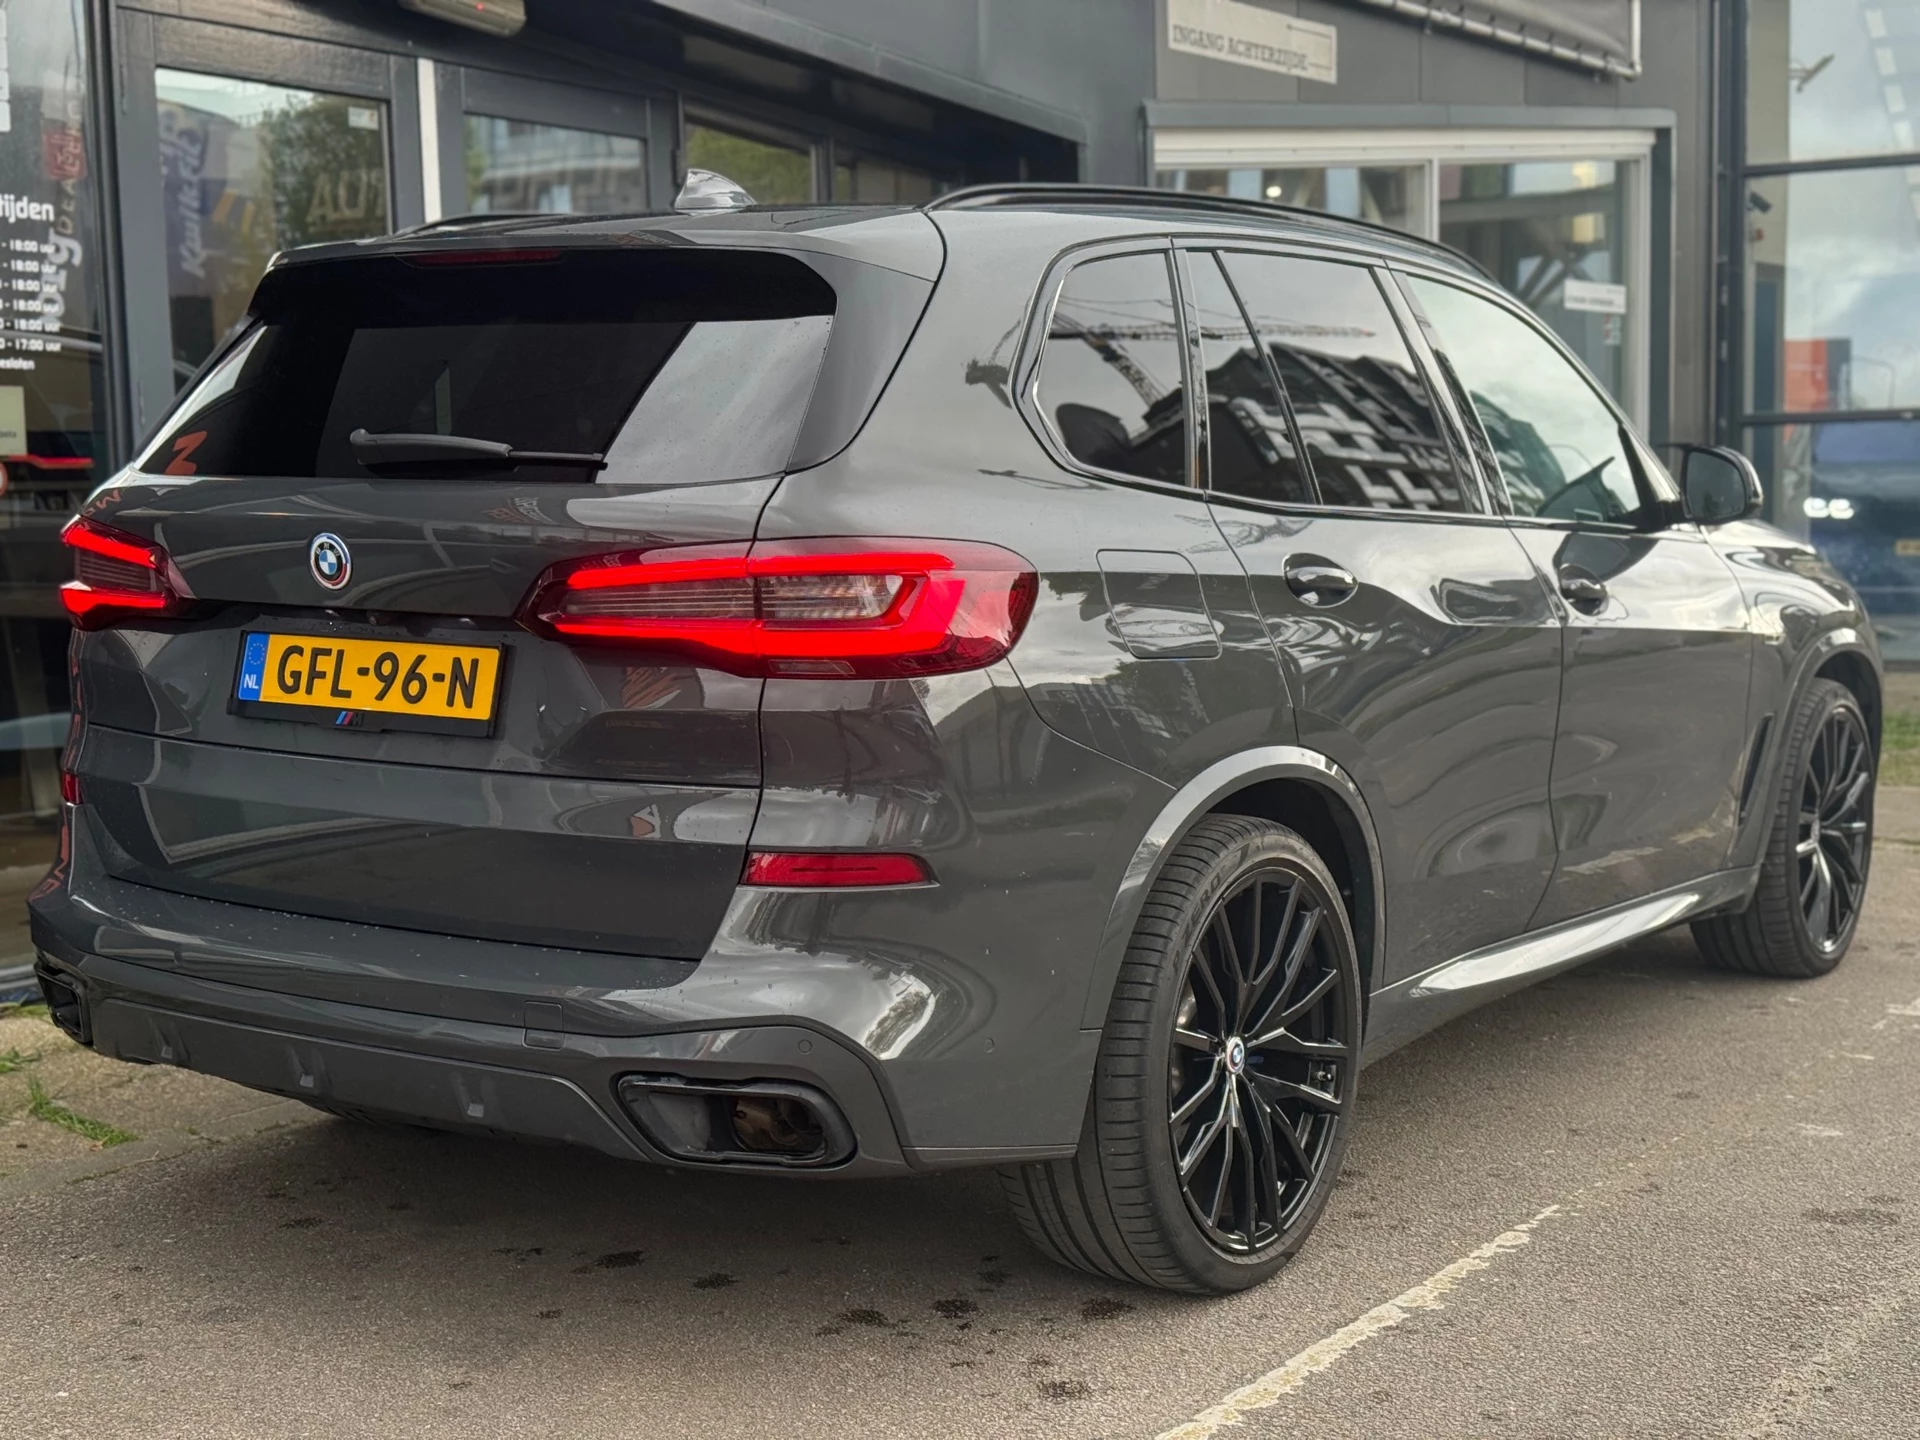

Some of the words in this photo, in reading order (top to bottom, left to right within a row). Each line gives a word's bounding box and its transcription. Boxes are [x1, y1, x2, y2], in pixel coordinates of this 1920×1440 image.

[1173, 24, 1225, 51] INGANG
[243, 674, 259, 690] NL
[277, 645, 480, 709] GFL-96-N
